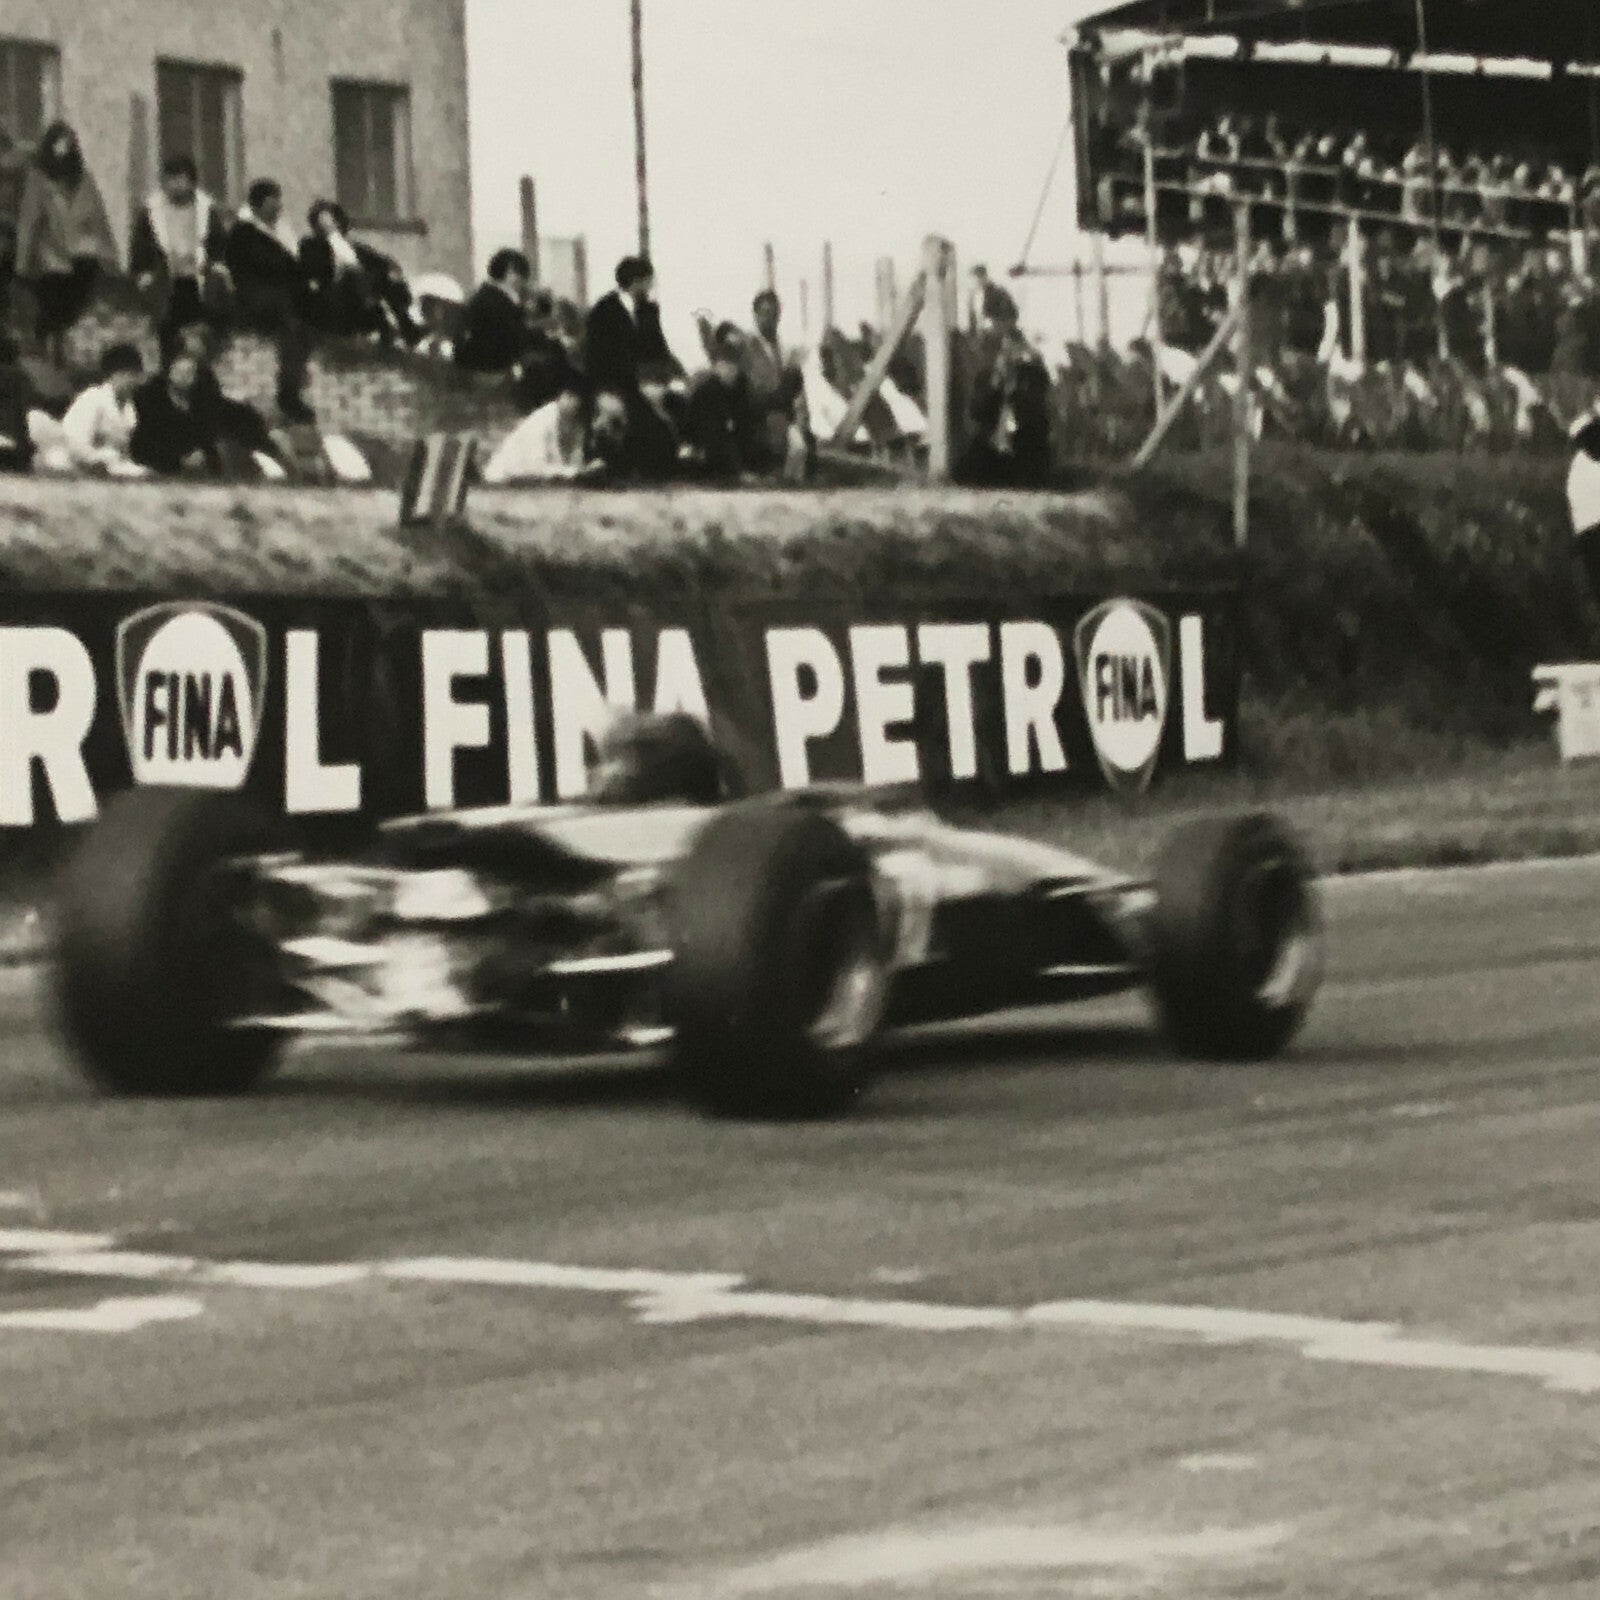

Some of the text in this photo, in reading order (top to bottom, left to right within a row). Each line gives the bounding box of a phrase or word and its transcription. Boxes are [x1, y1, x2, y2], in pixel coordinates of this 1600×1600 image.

[143, 669, 244, 762] FINA
[766, 597, 1224, 788] PETROL
[1096, 651, 1159, 722] FINA
